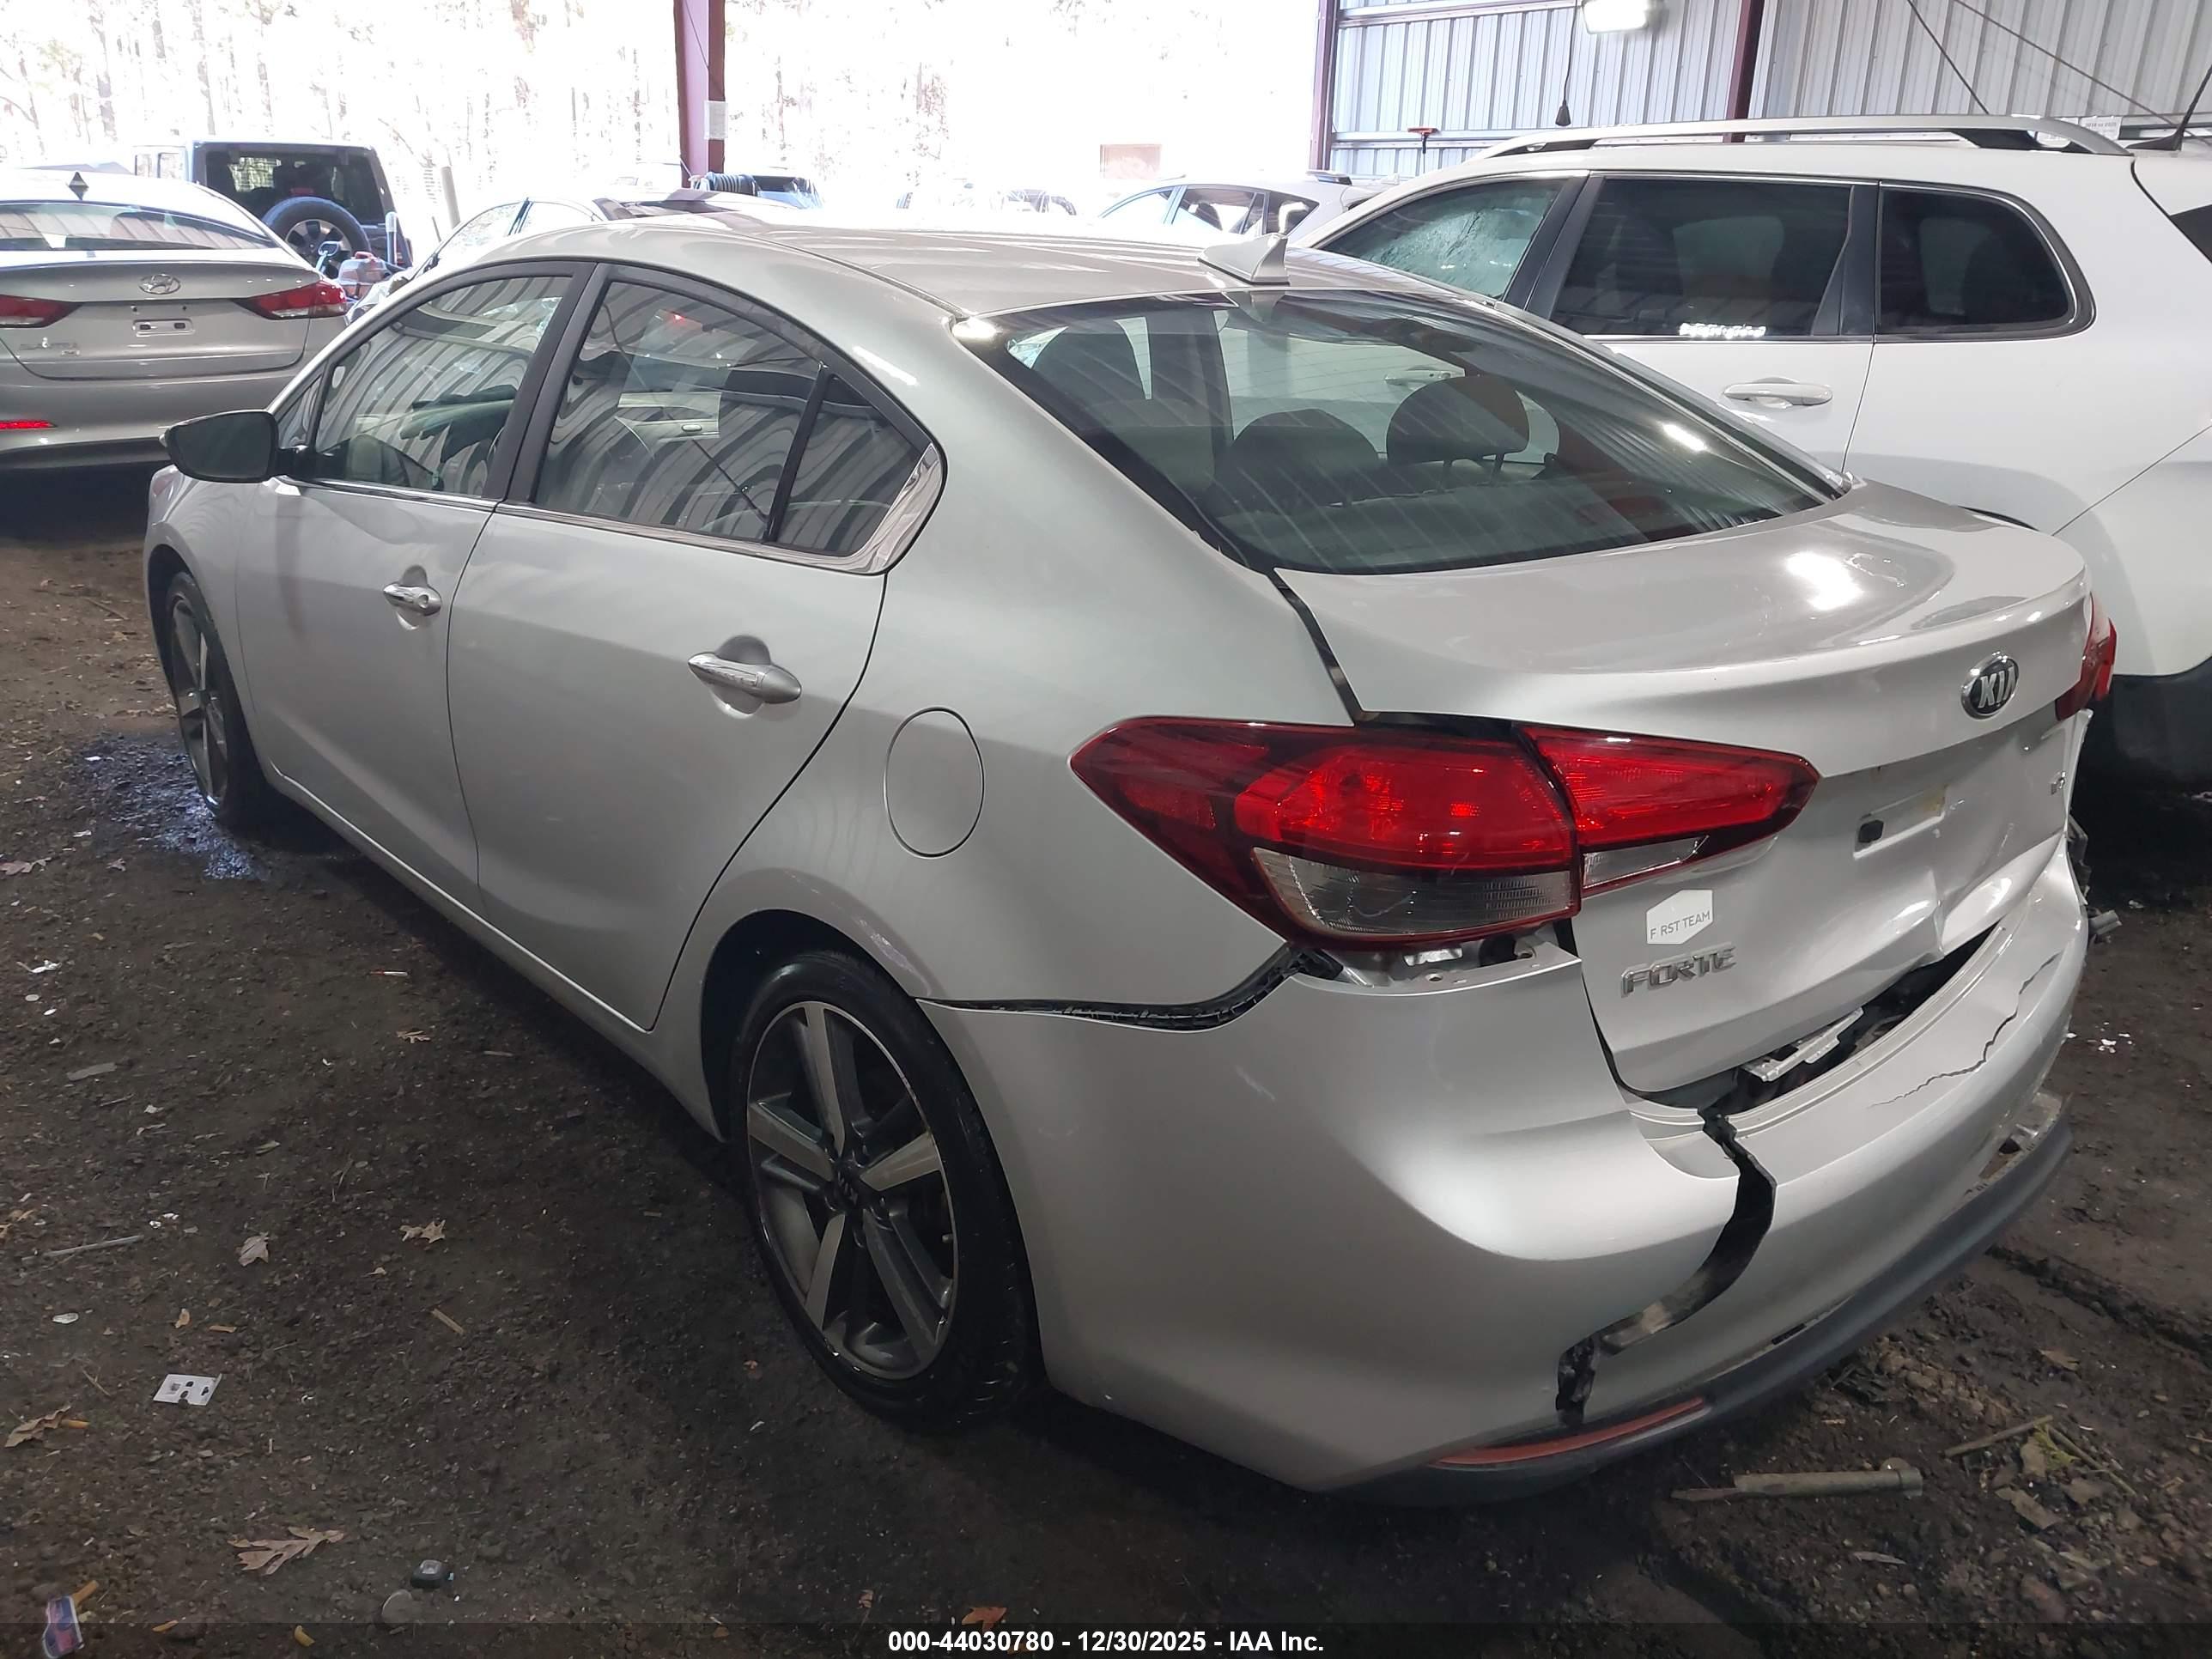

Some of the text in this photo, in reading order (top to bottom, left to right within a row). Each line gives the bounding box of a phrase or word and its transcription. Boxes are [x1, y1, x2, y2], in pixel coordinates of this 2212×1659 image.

[1978, 666, 2016, 708] KIA
[1682, 910, 1711, 927] TEAM
[1621, 945, 1736, 995] FORTE
